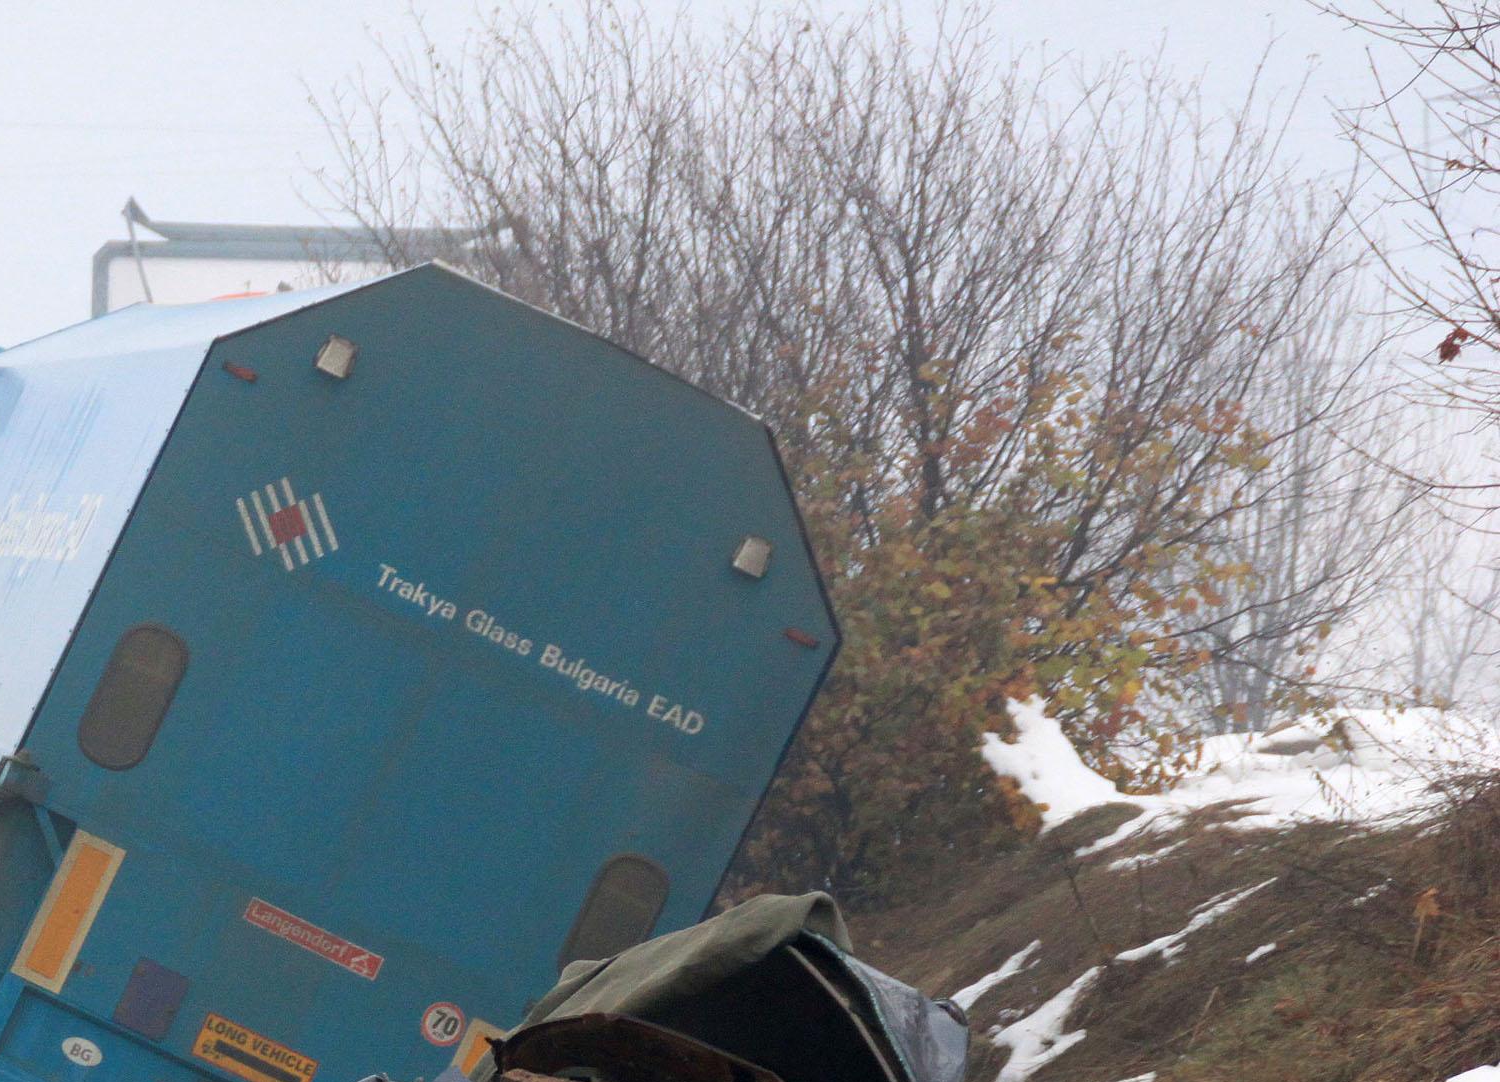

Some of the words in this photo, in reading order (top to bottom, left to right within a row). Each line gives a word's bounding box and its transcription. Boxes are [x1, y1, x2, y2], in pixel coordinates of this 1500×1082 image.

[377, 563, 457, 620] Trakya
[466, 609, 533, 656] Glass
[540, 643, 641, 707] Bulgaria
[647, 694, 705, 735] EAD
[250, 904, 349, 958] Langendorf
[206, 1018, 248, 1046] LONG
[251, 1038, 315, 1076] VEHICLE
[432, 1009, 459, 1036] 70
[70, 1042, 93, 1062] BG
